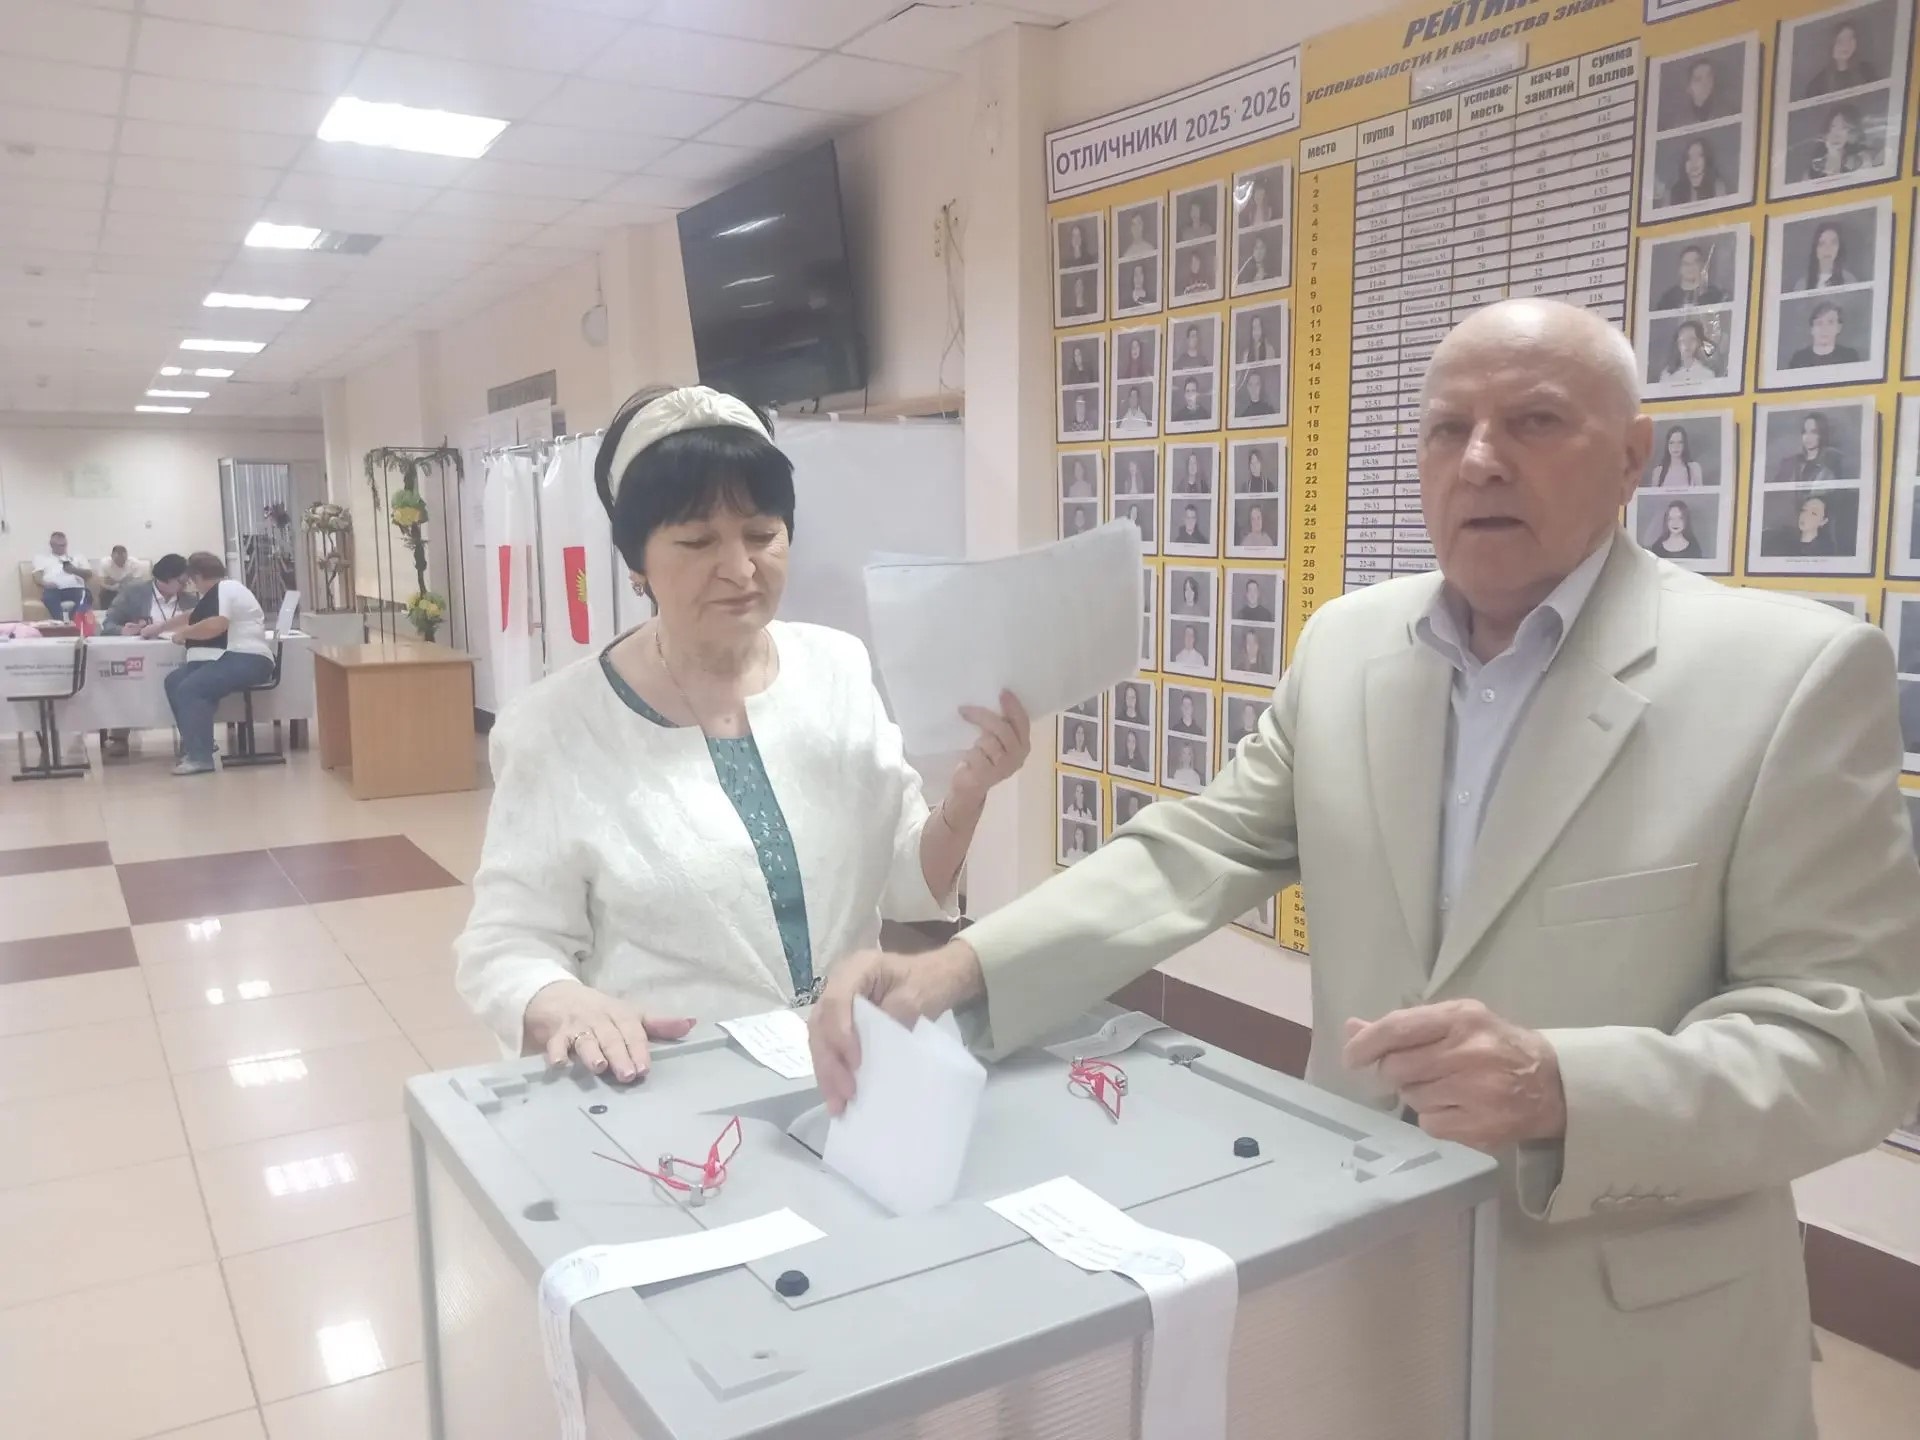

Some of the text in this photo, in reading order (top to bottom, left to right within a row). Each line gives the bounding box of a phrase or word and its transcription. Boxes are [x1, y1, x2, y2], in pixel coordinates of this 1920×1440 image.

[1402, 0, 1539, 49] РЕЙТИ
[1306, 51, 1432, 104] успеваемости
[1434, 46, 1450, 62] и
[1451, 11, 1549, 55] качества
[1591, 46, 1633, 69] сумма
[1530, 65, 1571, 86] кач-во
[1588, 65, 1635, 88] баллов
[1463, 84, 1513, 107] успевае-
[1524, 80, 1575, 105] занятий
[1470, 103, 1505, 121] мость
[1411, 107, 1453, 130] куратор
[1056, 82, 1292, 175] ОТЛИЧНИКИ 2025 2026
[1362, 125, 1395, 144] группа
[1307, 142, 1337, 159] место
[1313, 173, 1319, 184] 1
[1312, 188, 1320, 199] 2
[1312, 203, 1319, 214] 3
[1311, 217, 1319, 227] 4
[1311, 232, 1318, 242] 5
[1311, 247, 1318, 256] 6
[1311, 261, 1318, 271] 7
[1310, 276, 1317, 286] 8
[1309, 290, 1317, 300] 9
[1310, 304, 1323, 314] 10
[1309, 318, 1321, 329] 11
[1309, 332, 1322, 344] 12
[1308, 347, 1322, 357] 13
[1308, 361, 1321, 372] 14
[1308, 376, 1321, 386] 15
[1308, 390, 1321, 400] 16
[1307, 404, 1320, 415] 17
[1306, 419, 1320, 429] 18
[1306, 433, 1320, 443] 19
[1305, 447, 1319, 457] 20
[1305, 461, 1318, 471] 21
[1304, 475, 1318, 485] 22
[1304, 489, 1318, 499] 23
[1304, 503, 1317, 513] 24
[1303, 517, 1317, 527] 25
[1303, 531, 1317, 541] 26
[1303, 545, 1317, 554] 27
[1302, 559, 1316, 568] 28
[1301, 572, 1315, 582] 29
[1301, 586, 1315, 595] 30
[1301, 599, 1314, 609] 31
[1294, 903, 1306, 912] 54
[1294, 916, 1306, 926] 55
[1293, 929, 1305, 939] 56
[1293, 942, 1305, 951] 57
